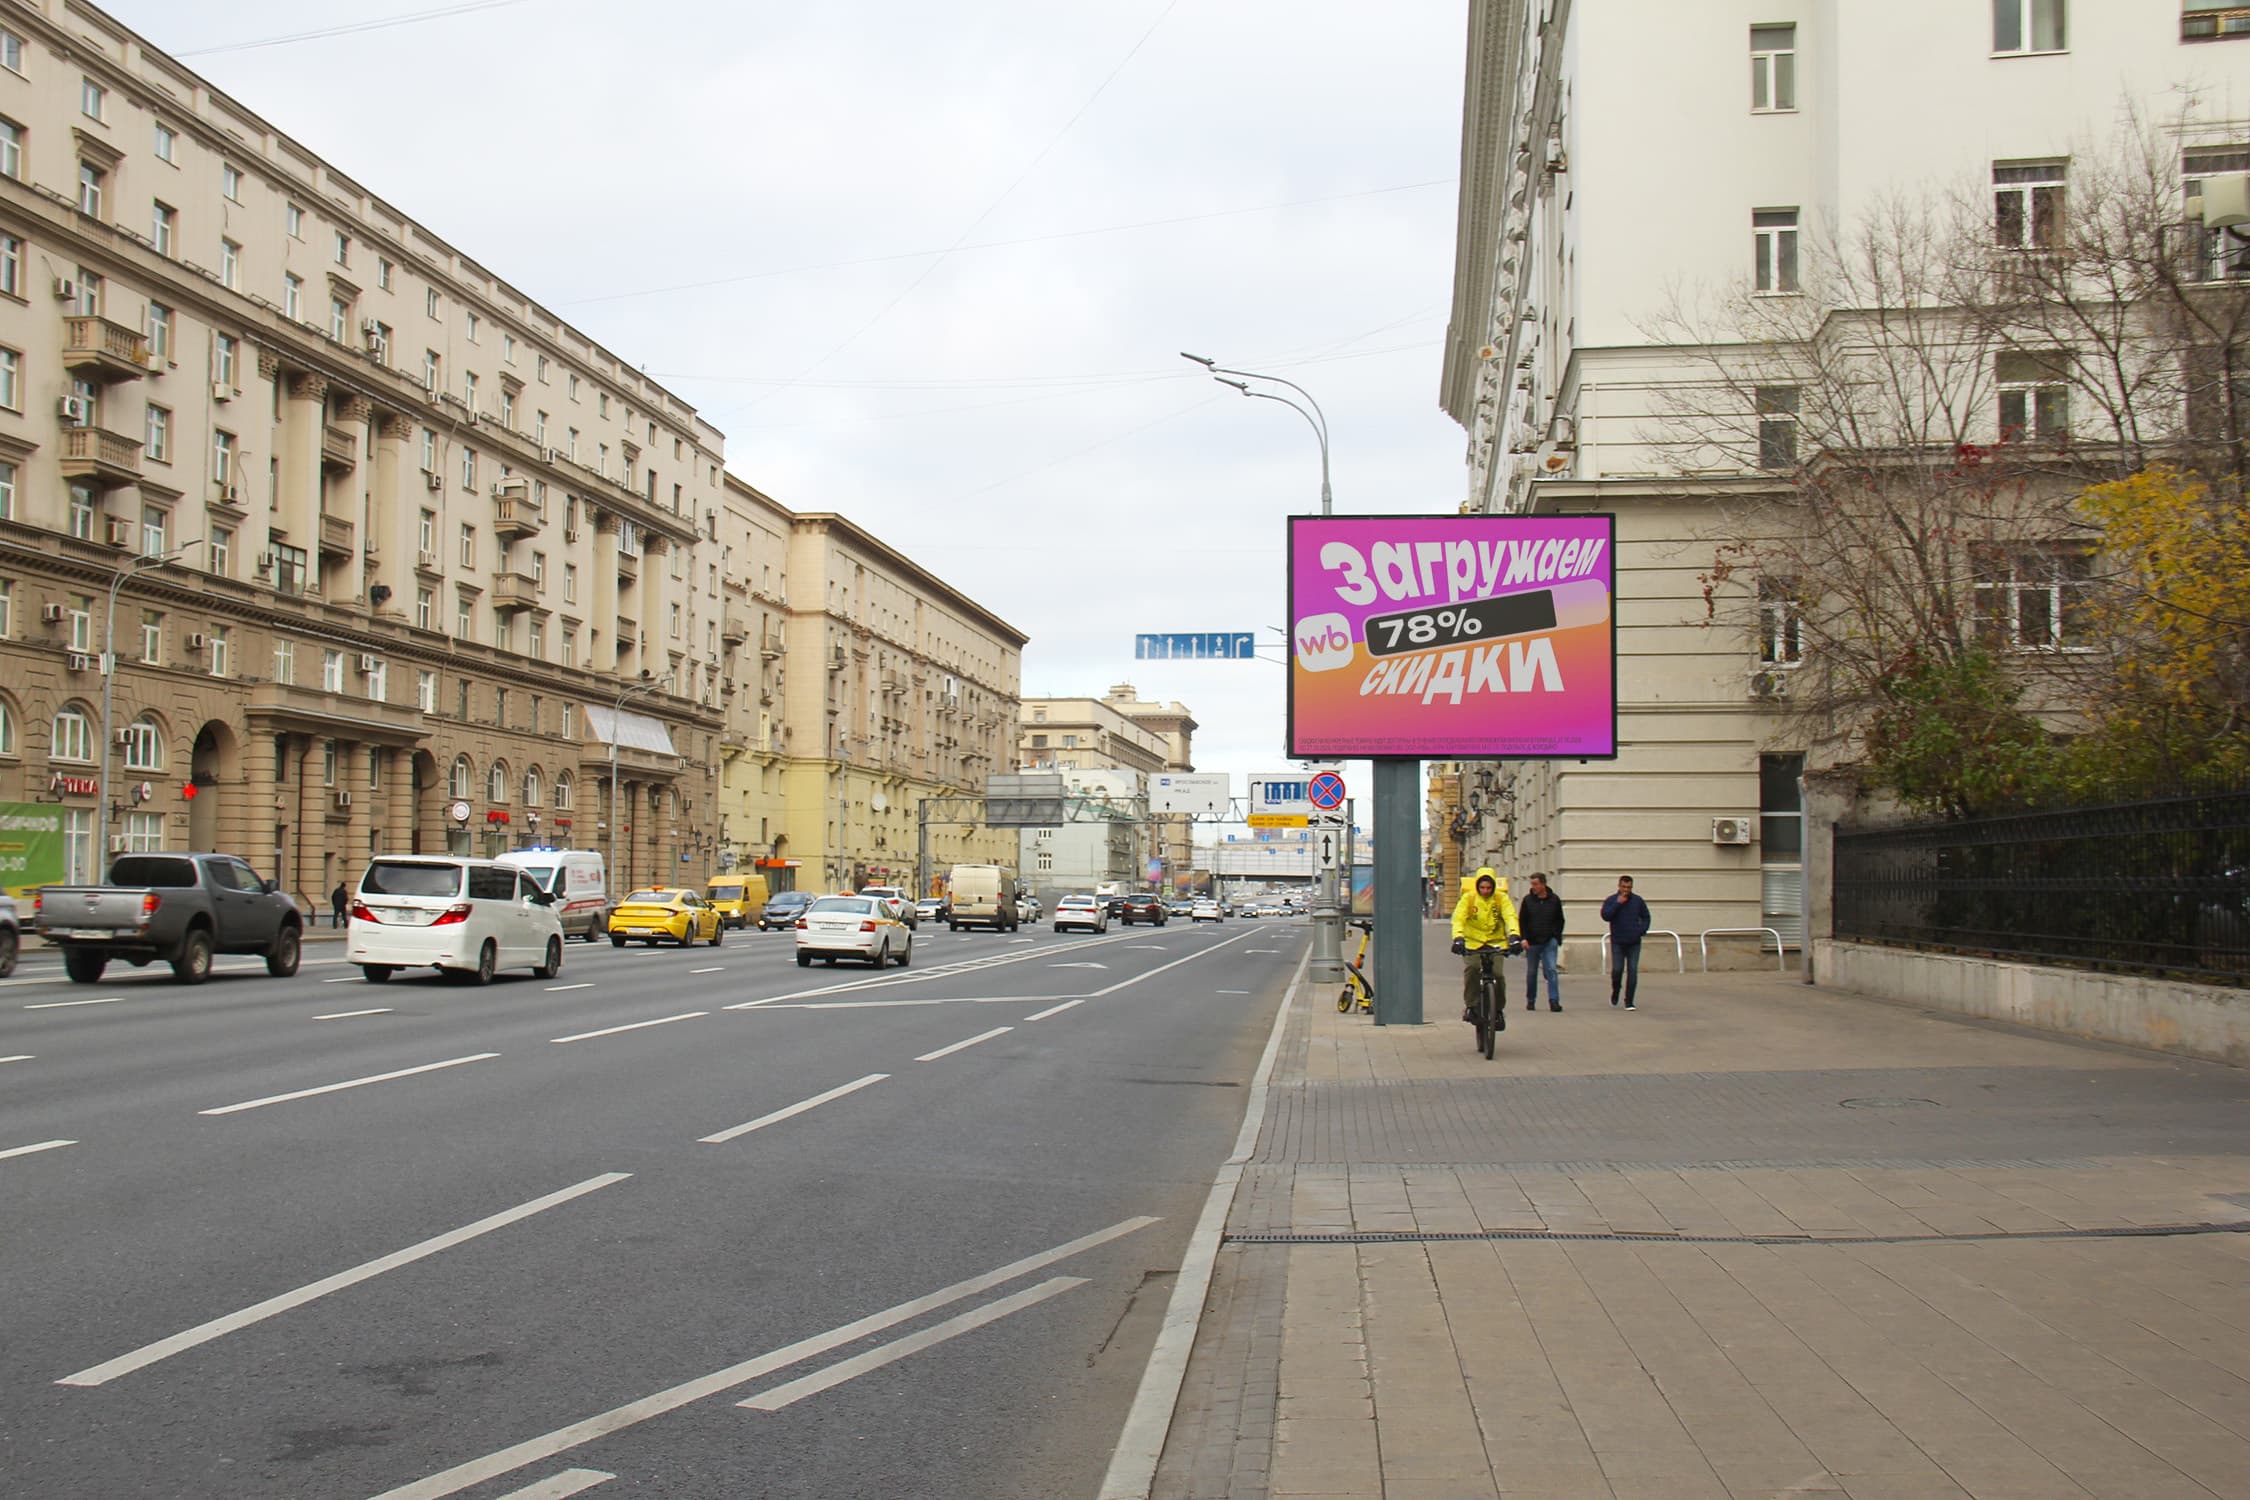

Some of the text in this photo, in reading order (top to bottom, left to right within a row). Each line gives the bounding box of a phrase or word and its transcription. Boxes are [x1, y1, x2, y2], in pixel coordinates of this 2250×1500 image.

[1319, 537, 1607, 606] Загружаем
[1298, 625, 1349, 656] wb
[1378, 608, 1483, 649] 78%
[1359, 637, 1565, 705] скидки
